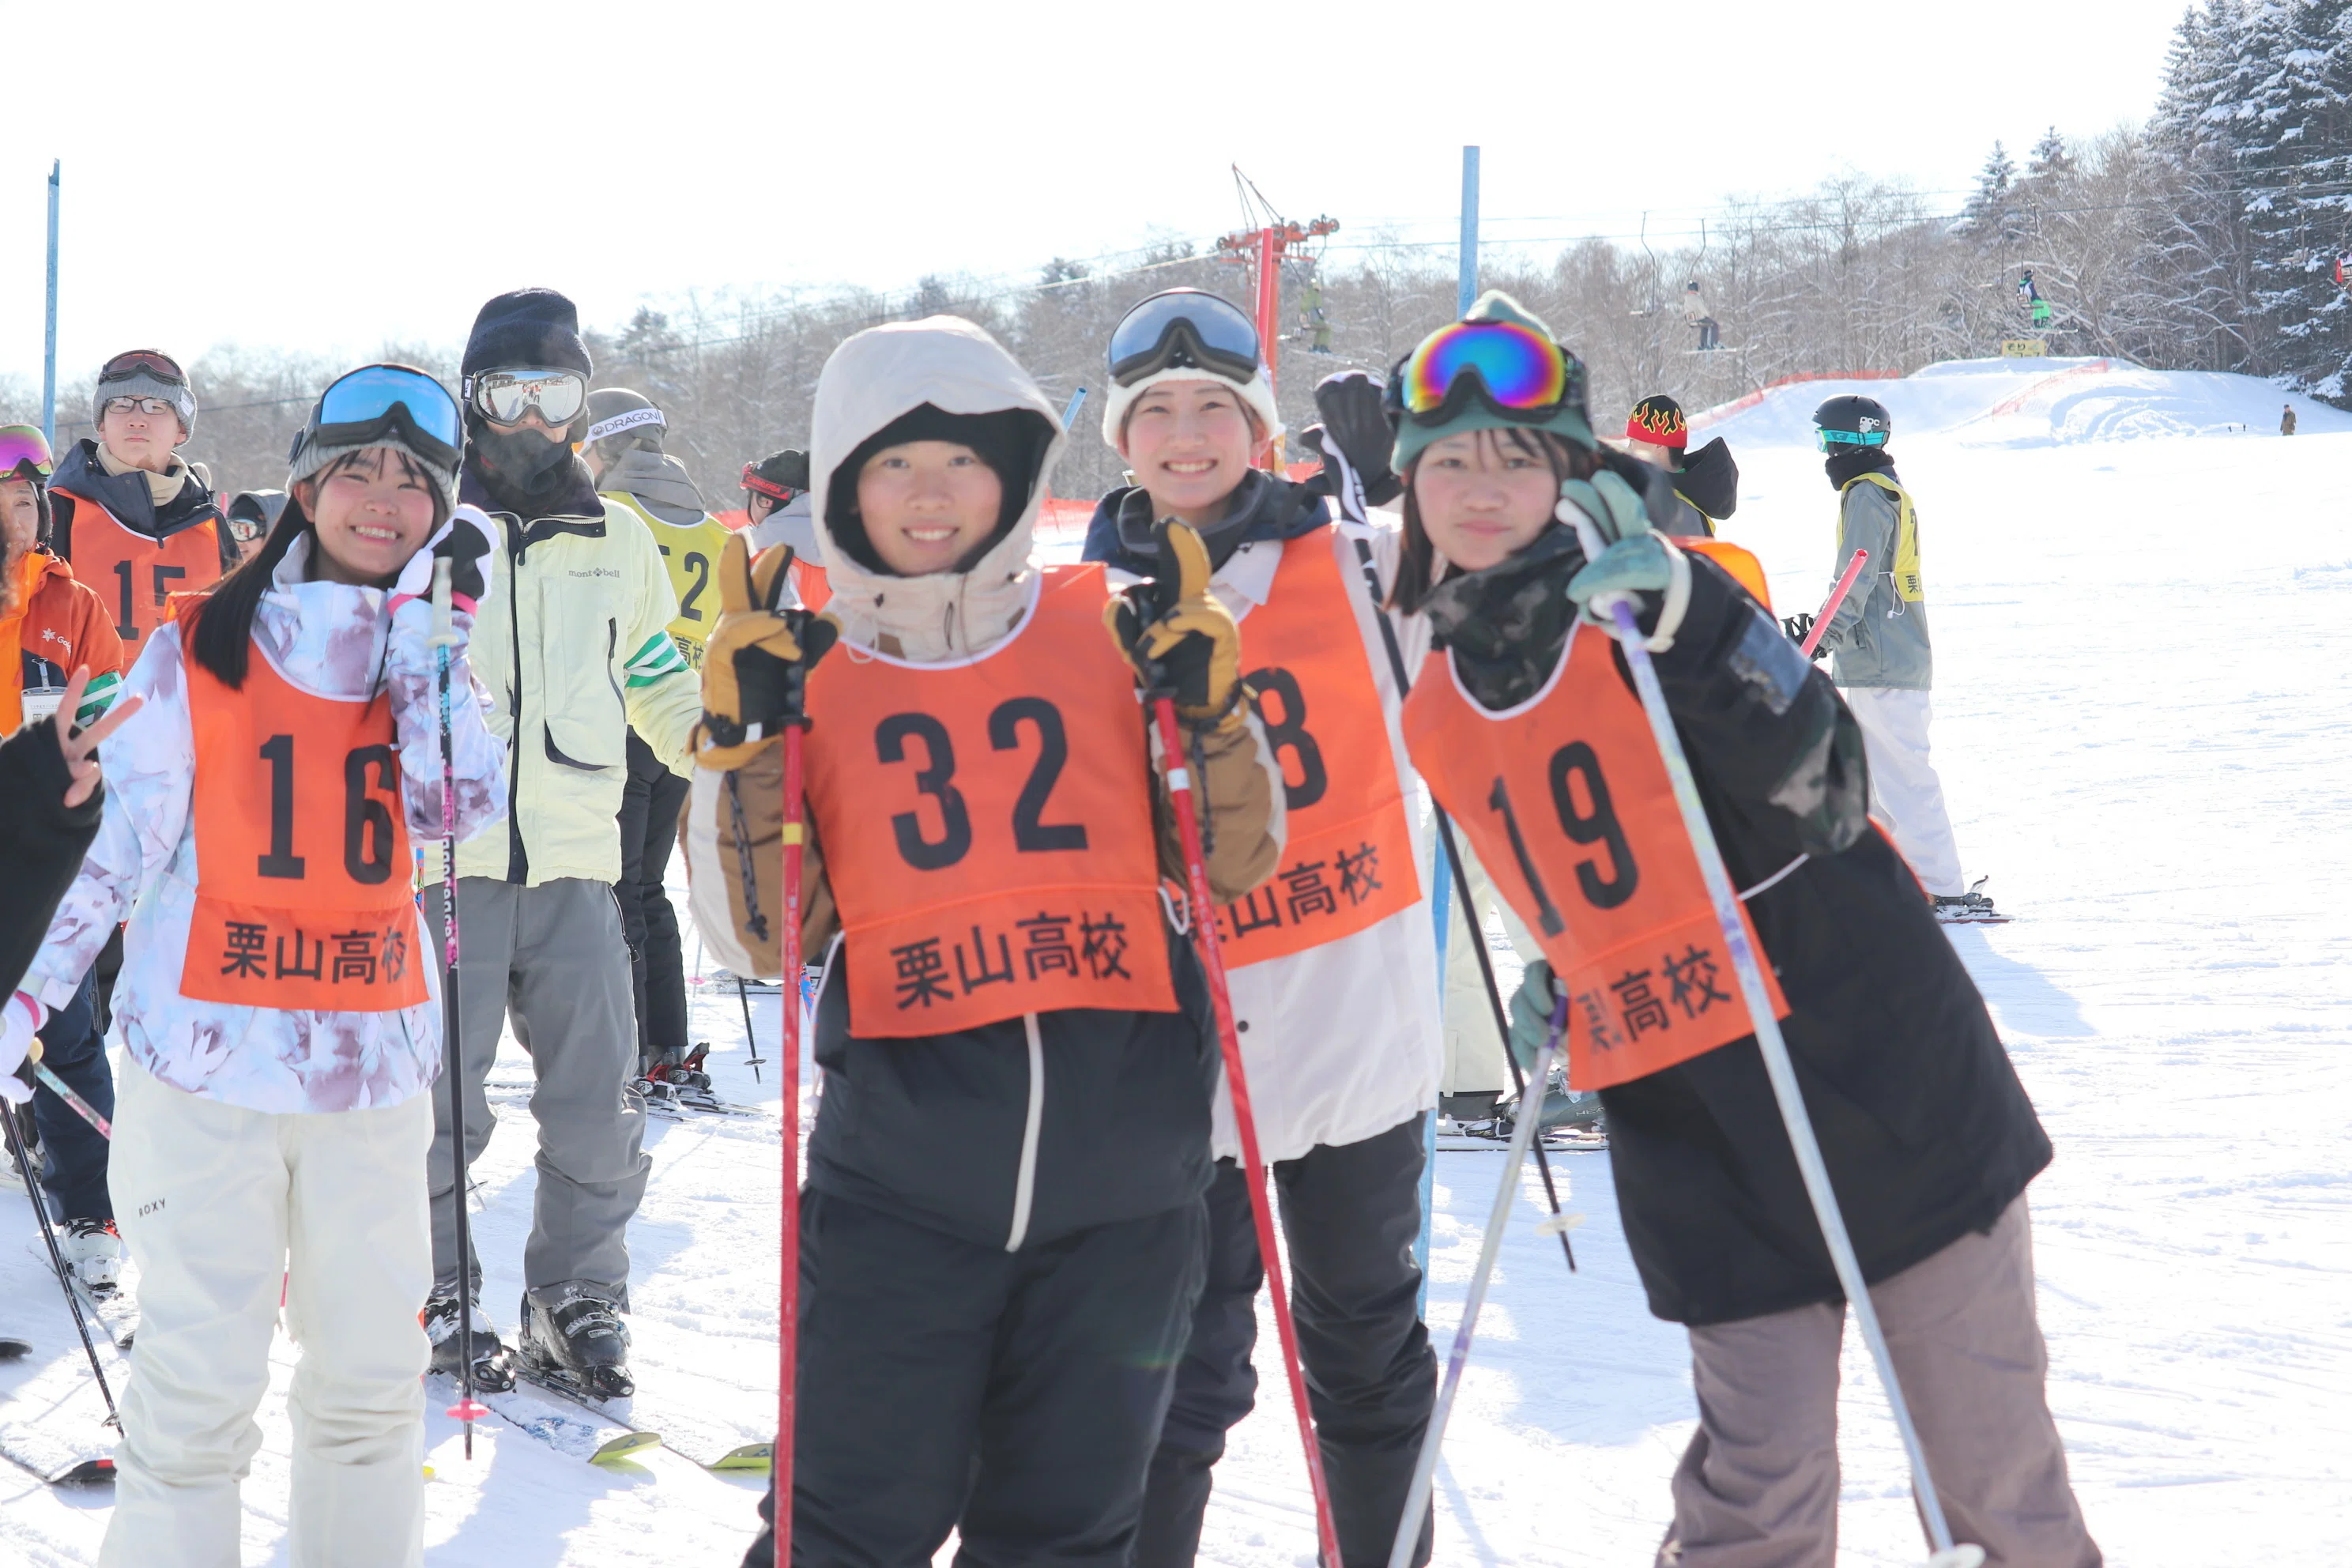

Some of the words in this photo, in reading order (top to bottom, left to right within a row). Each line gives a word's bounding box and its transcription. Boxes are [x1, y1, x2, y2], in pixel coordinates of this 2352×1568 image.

[604, 412, 659, 435] DRAGON
[568, 568, 593, 579] mont
[603, 567, 620, 579] bell
[660, 545, 709, 622] 2
[258, 734, 395, 886] 16
[874, 696, 1089, 872] 32
[1488, 740, 1639, 938] 19
[1174, 842, 1383, 944] 山高校
[220, 921, 407, 986] 栗山高校
[890, 910, 1132, 1011] 栗山高校
[138, 1197, 165, 1219] ROXY
